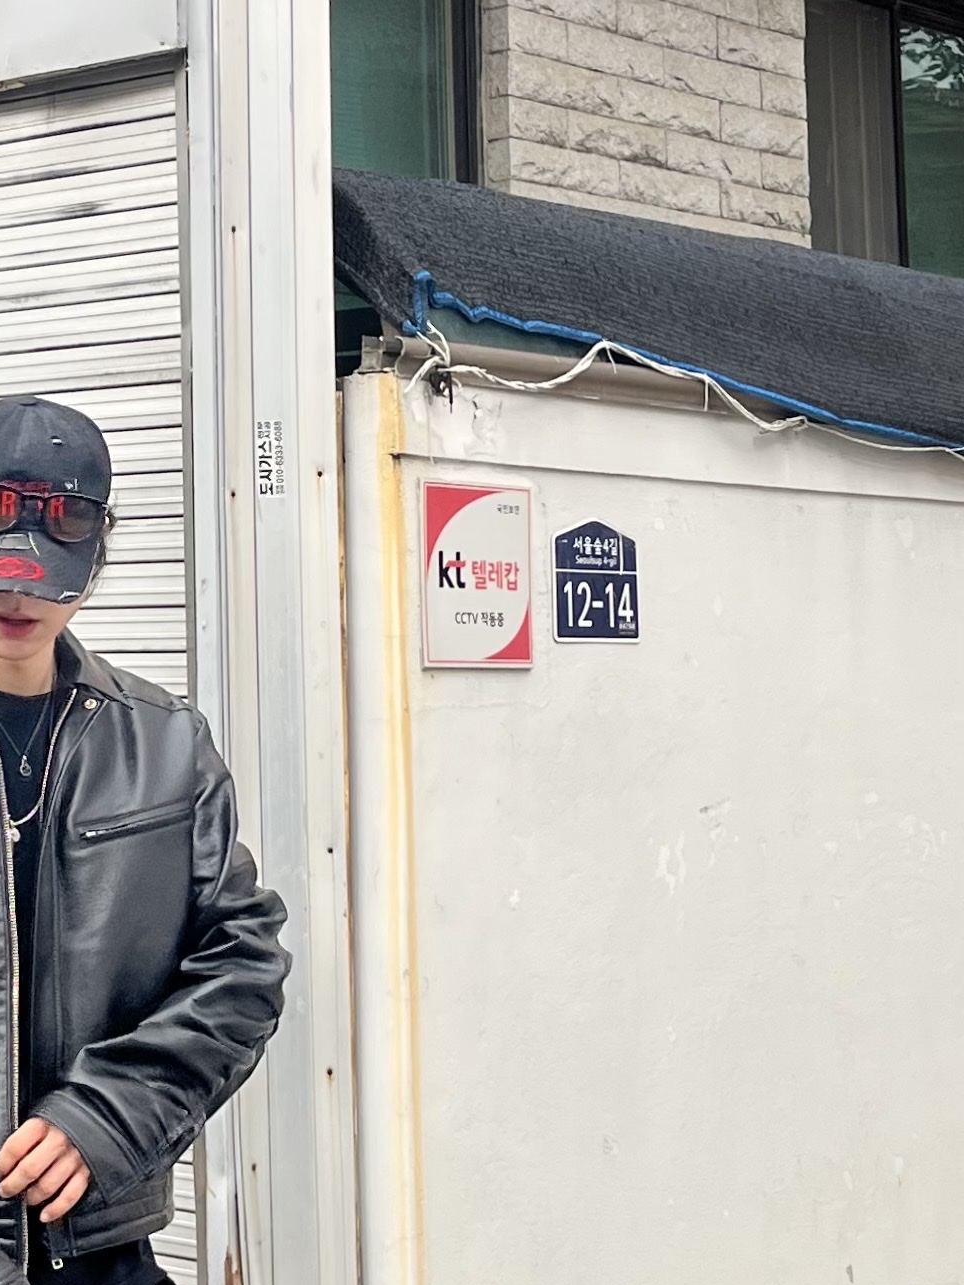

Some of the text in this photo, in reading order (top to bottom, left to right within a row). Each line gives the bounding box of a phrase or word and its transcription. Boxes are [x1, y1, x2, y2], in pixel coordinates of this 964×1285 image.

[258, 440, 273, 495] 도시가스
[572, 535, 618, 556] 서울숲4길
[438, 550, 520, 592] kt 텔레캅
[454, 611, 505, 628] CCTV 작동중
[563, 580, 634, 628] 12-14
